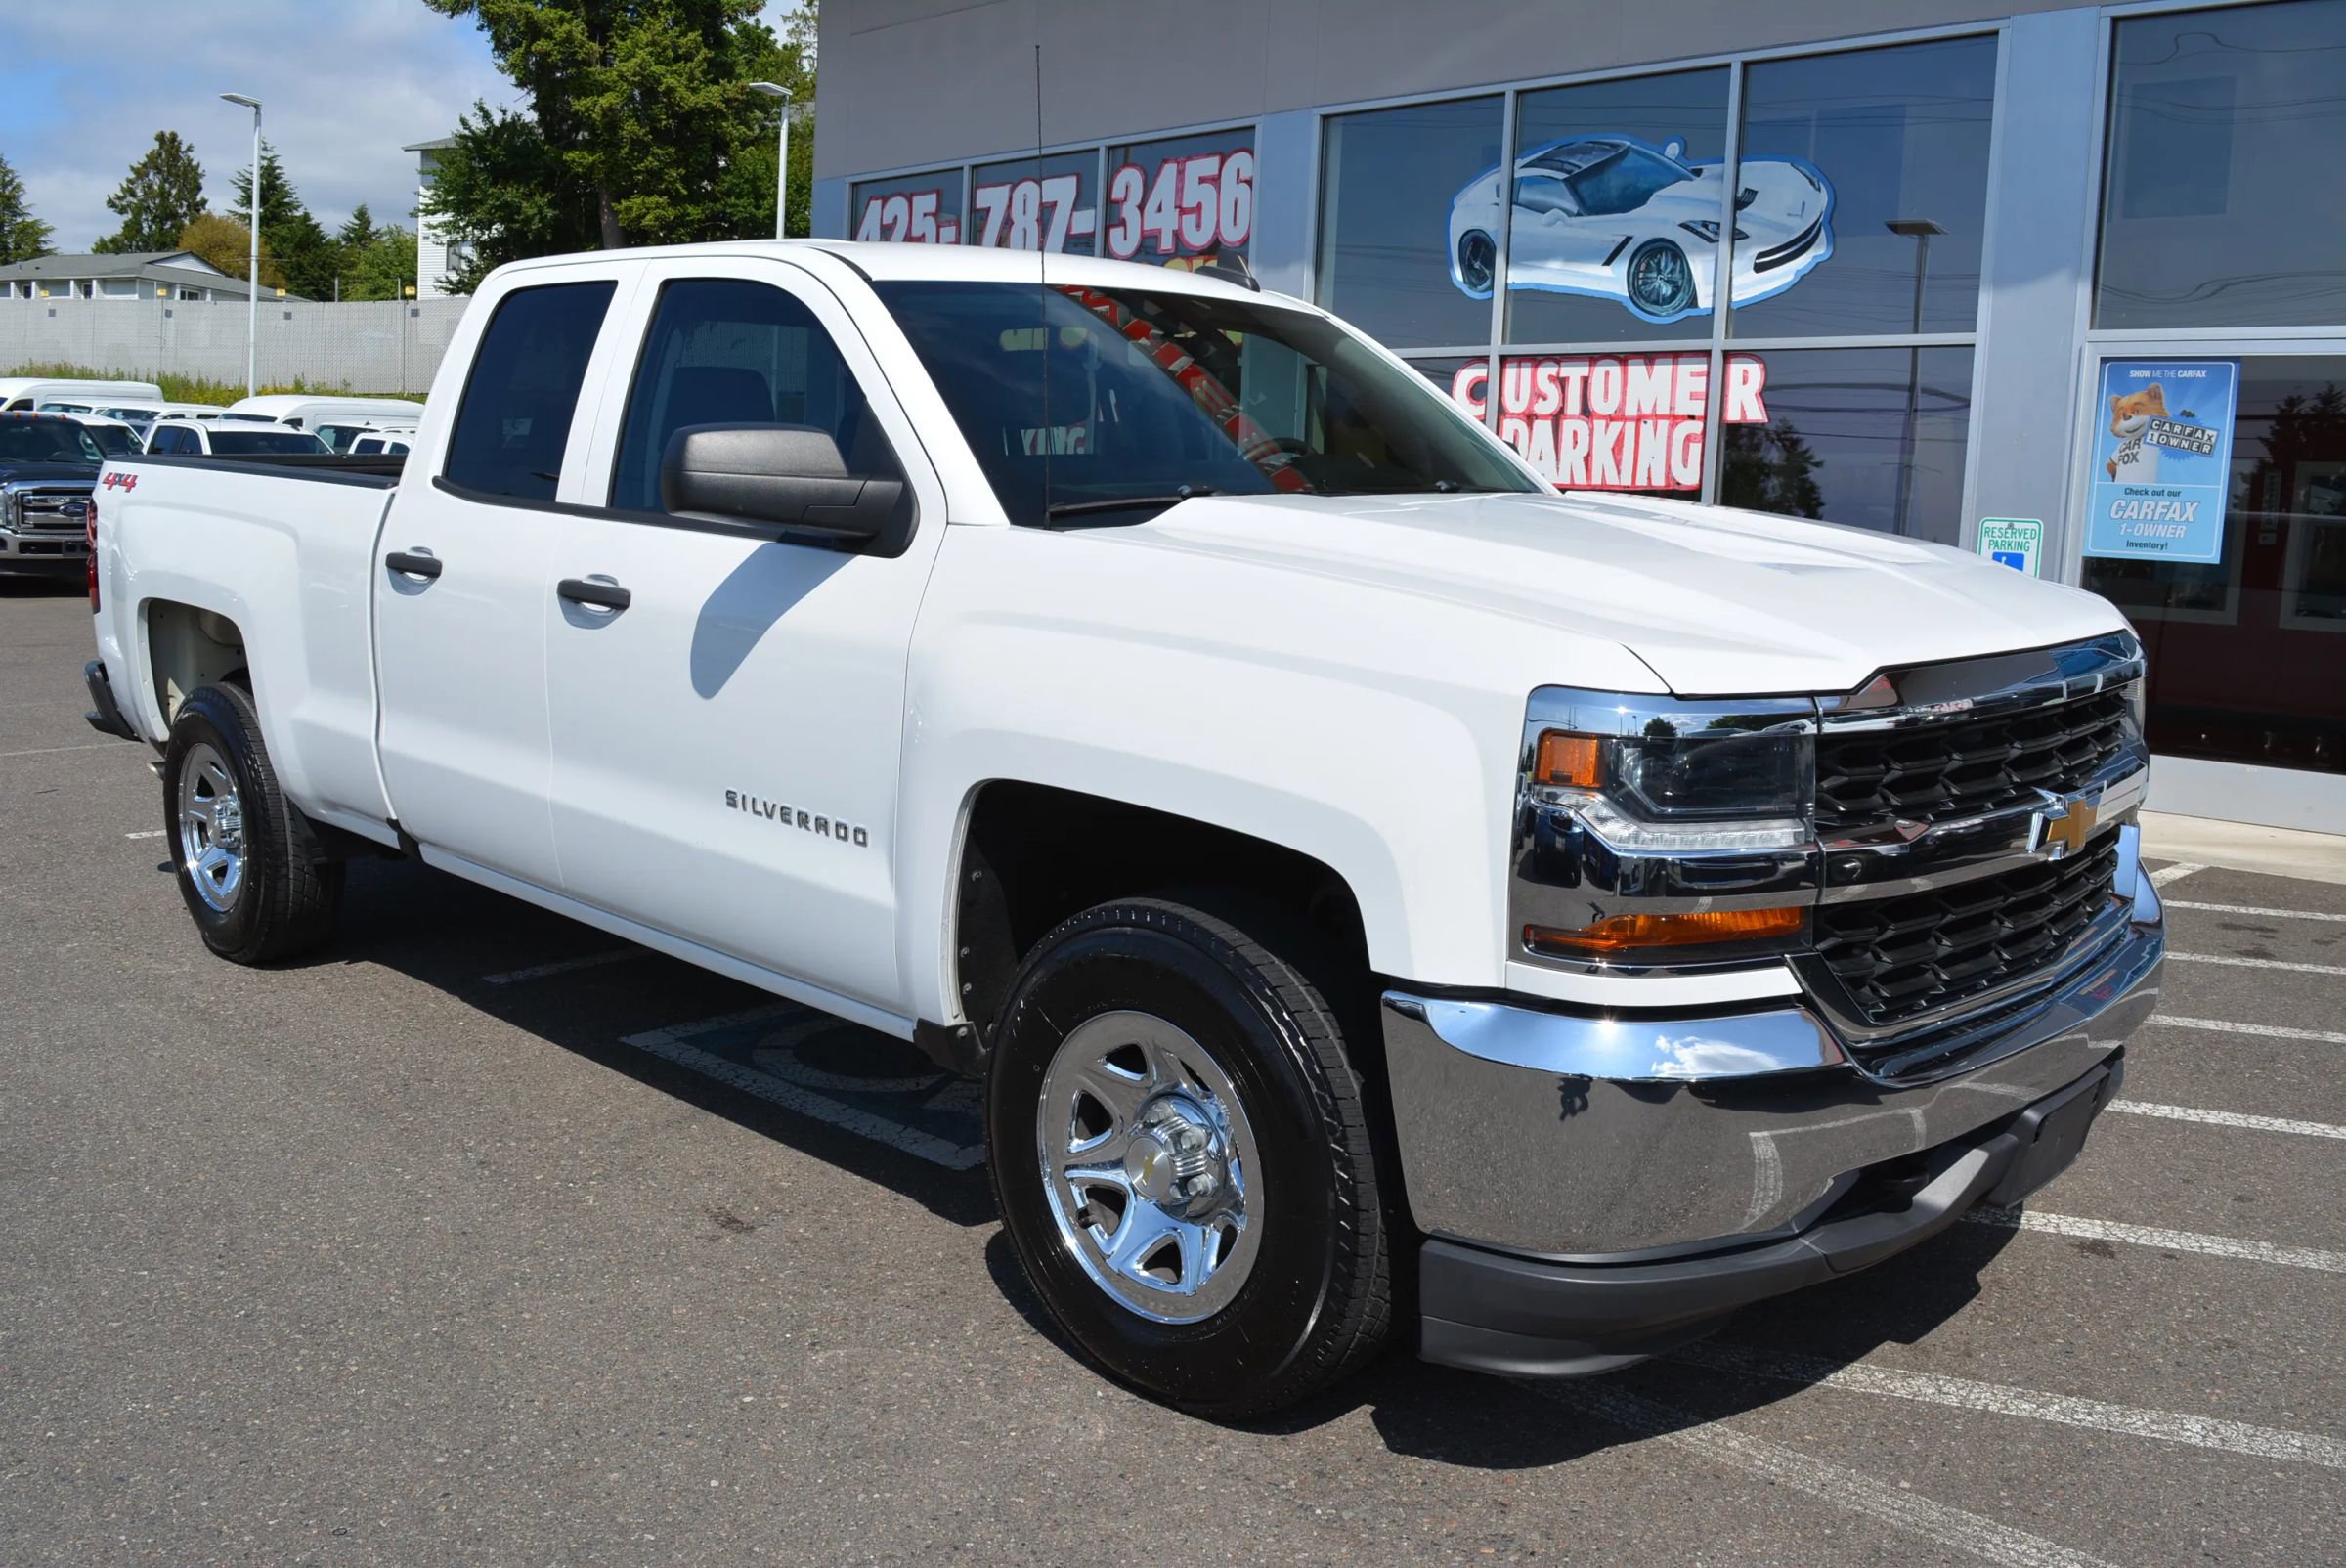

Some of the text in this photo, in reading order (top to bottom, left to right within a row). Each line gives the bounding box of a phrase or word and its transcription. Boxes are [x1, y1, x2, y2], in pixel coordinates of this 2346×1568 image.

[1108, 148, 1255, 260] 3456
[2129, 370, 2151, 378] SHOW
[1452, 353, 1769, 423] CUSTOMER
[2150, 419, 2216, 443] CARFAX
[2118, 438, 2142, 454] CAR
[2157, 435, 2214, 456] OWNER
[2117, 451, 2140, 465] FOX
[2109, 500, 2199, 523] CARFAX
[1983, 526, 2038, 540] RESERVED
[2119, 523, 2187, 538] 1-OWNER
[1988, 539, 2031, 552] PARKING
[2126, 540, 2168, 550] Inventory!
[725, 788, 868, 849] SILVERADO
